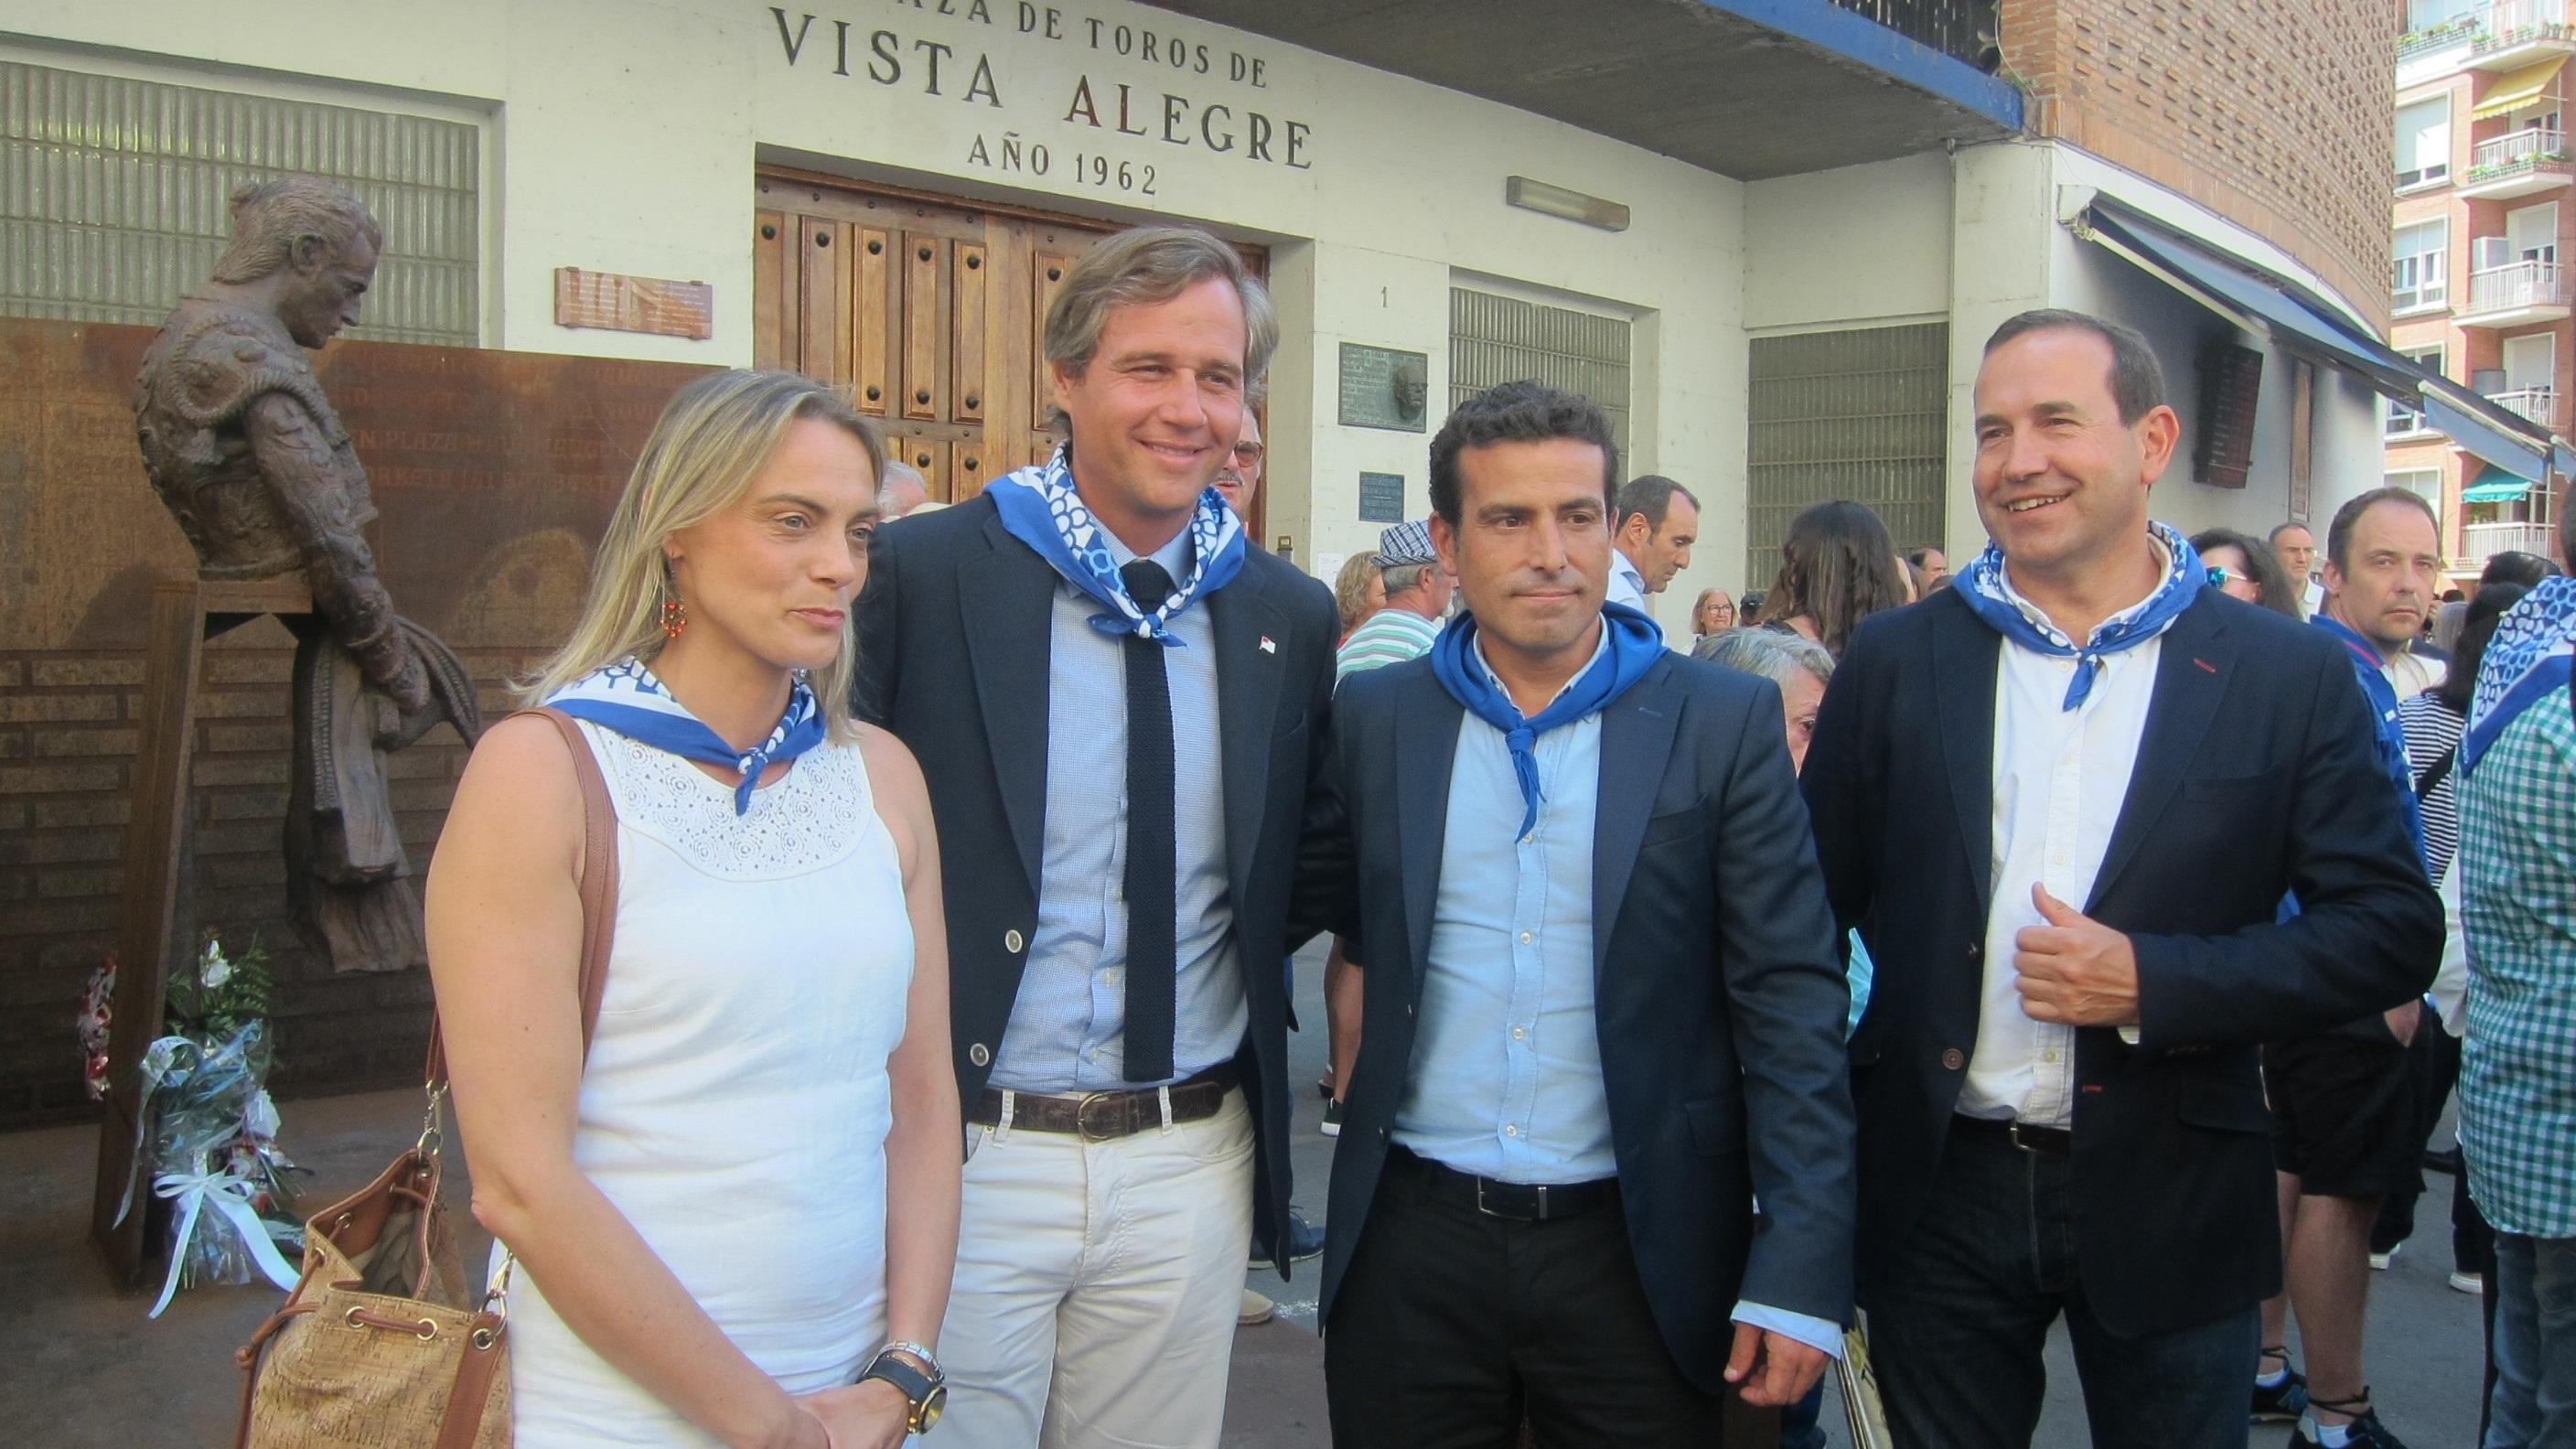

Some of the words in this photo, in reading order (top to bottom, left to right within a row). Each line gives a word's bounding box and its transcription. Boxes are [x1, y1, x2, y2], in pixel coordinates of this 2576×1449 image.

[1018, 1, 1063, 40] DE
[1085, 17, 1209, 75] TOROS
[1230, 51, 1267, 89] DE
[768, 6, 1004, 109] VISTA
[1063, 75, 1312, 170] ALEGRE
[968, 132, 1050, 177] AÑO
[1077, 153, 1156, 197] 1962
[1380, 285, 1389, 308] 1
